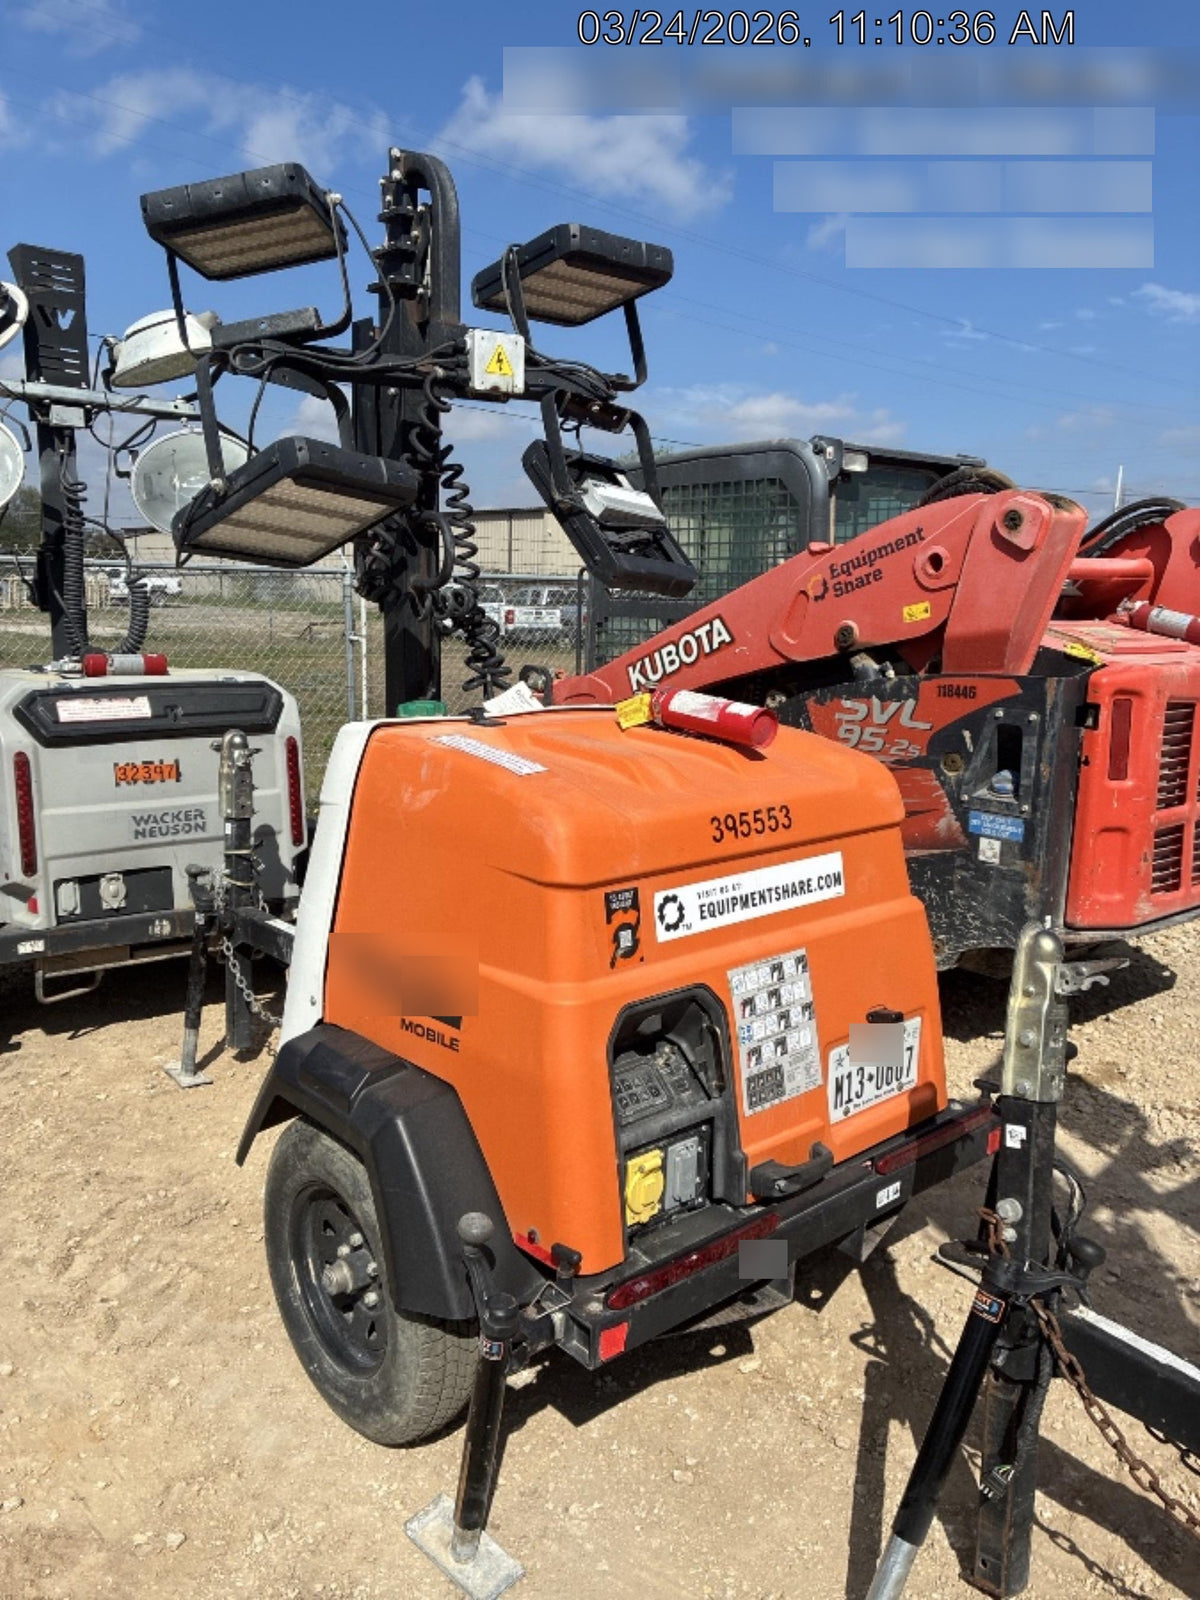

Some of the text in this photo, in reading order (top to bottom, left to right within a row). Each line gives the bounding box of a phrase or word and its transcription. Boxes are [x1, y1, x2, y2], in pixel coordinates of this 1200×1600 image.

[829, 526, 926, 579] Equipment
[626, 616, 733, 694] KUBOTA
[937, 684, 977, 699] 118446
[836, 696, 933, 730] SVL
[131, 808, 206, 827] WACKER
[133, 821, 208, 840] NEUSON
[710, 804, 792, 844] 395553
[698, 871, 842, 921] EQUIPMENTSHARE.COM
[401, 1017, 461, 1053] MOBILE
